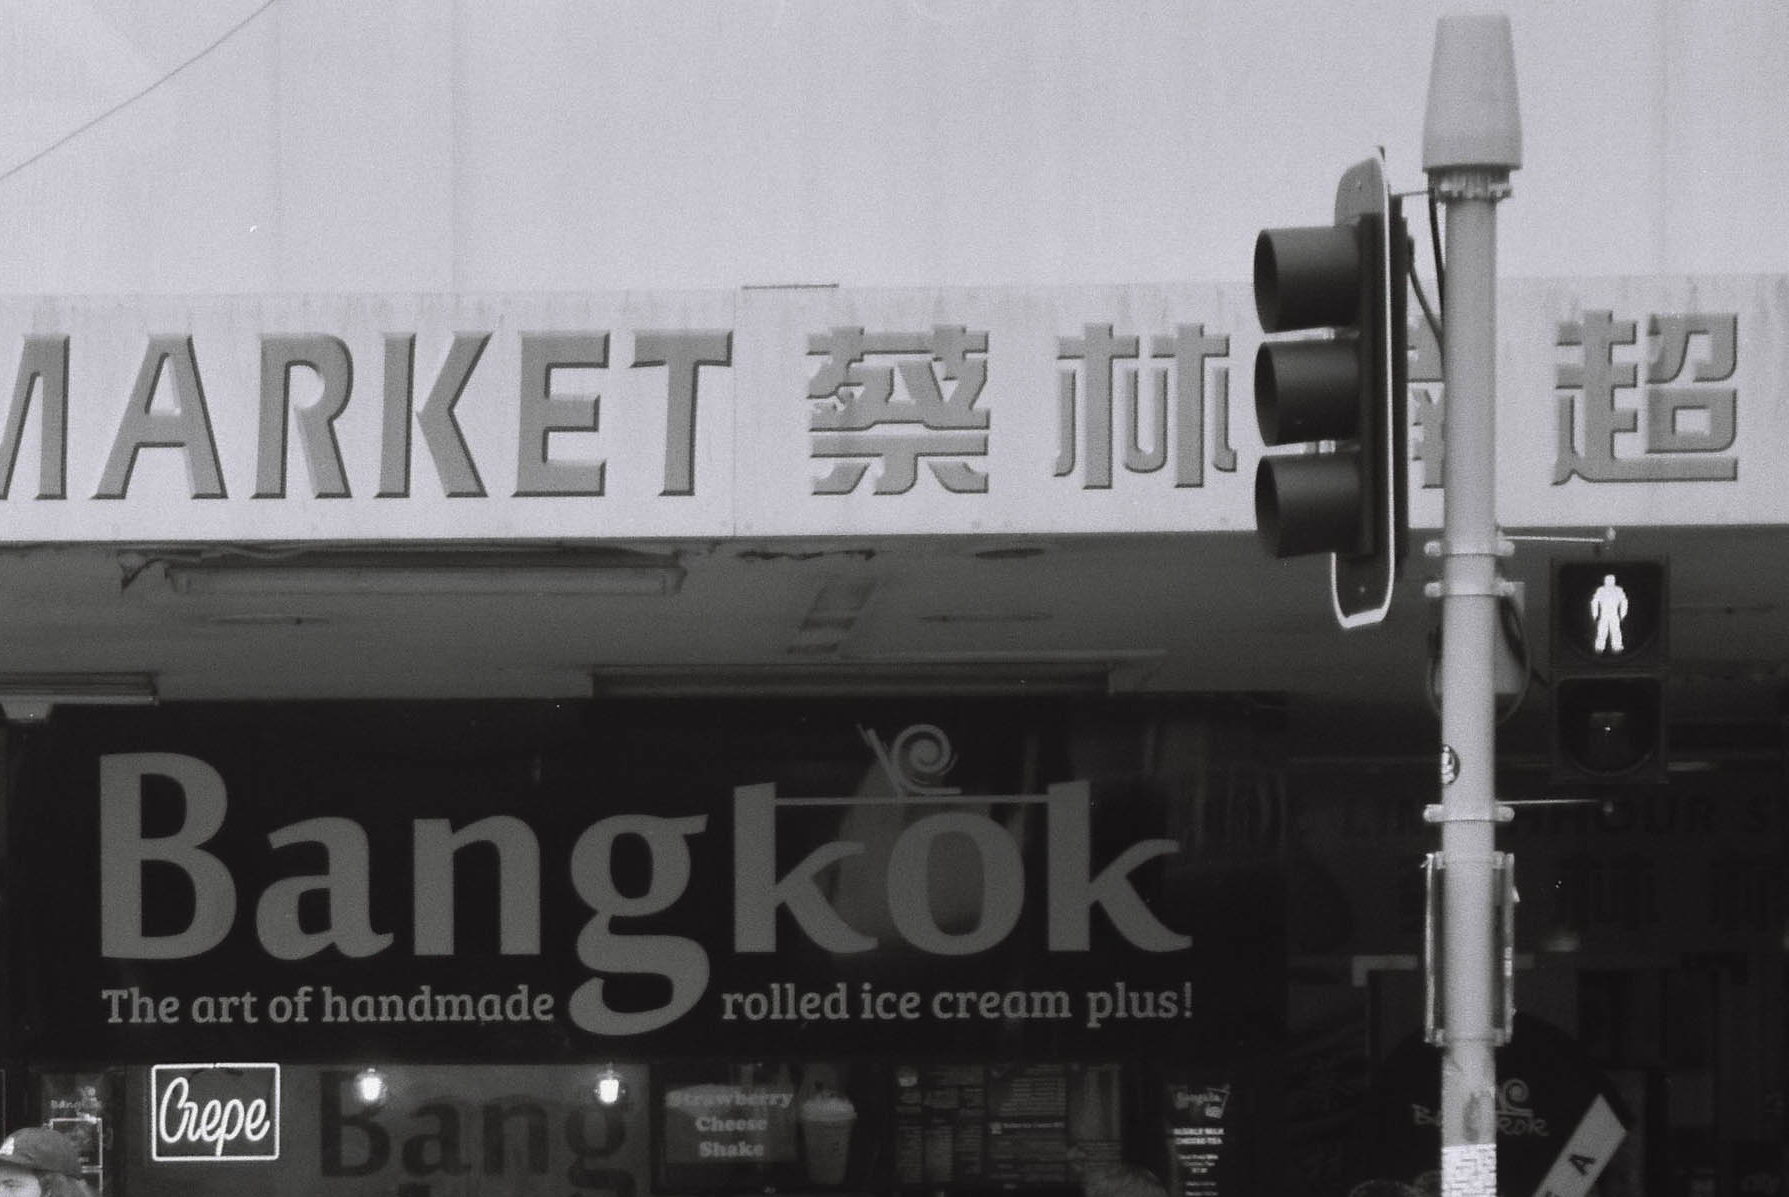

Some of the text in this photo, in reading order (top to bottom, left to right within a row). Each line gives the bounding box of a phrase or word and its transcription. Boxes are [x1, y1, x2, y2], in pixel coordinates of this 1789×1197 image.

[807, 308, 1740, 497] 蔡林超
[99, 751, 1194, 1036] Bangkok
[102, 982, 1194, 1028] The art of handmade rolled ice cream plus!
[158, 1076, 270, 1157] Crepe
[667, 1090, 794, 1109] Strawberry
[695, 1116, 768, 1132] Cheese
[699, 1141, 765, 1158] Shake
